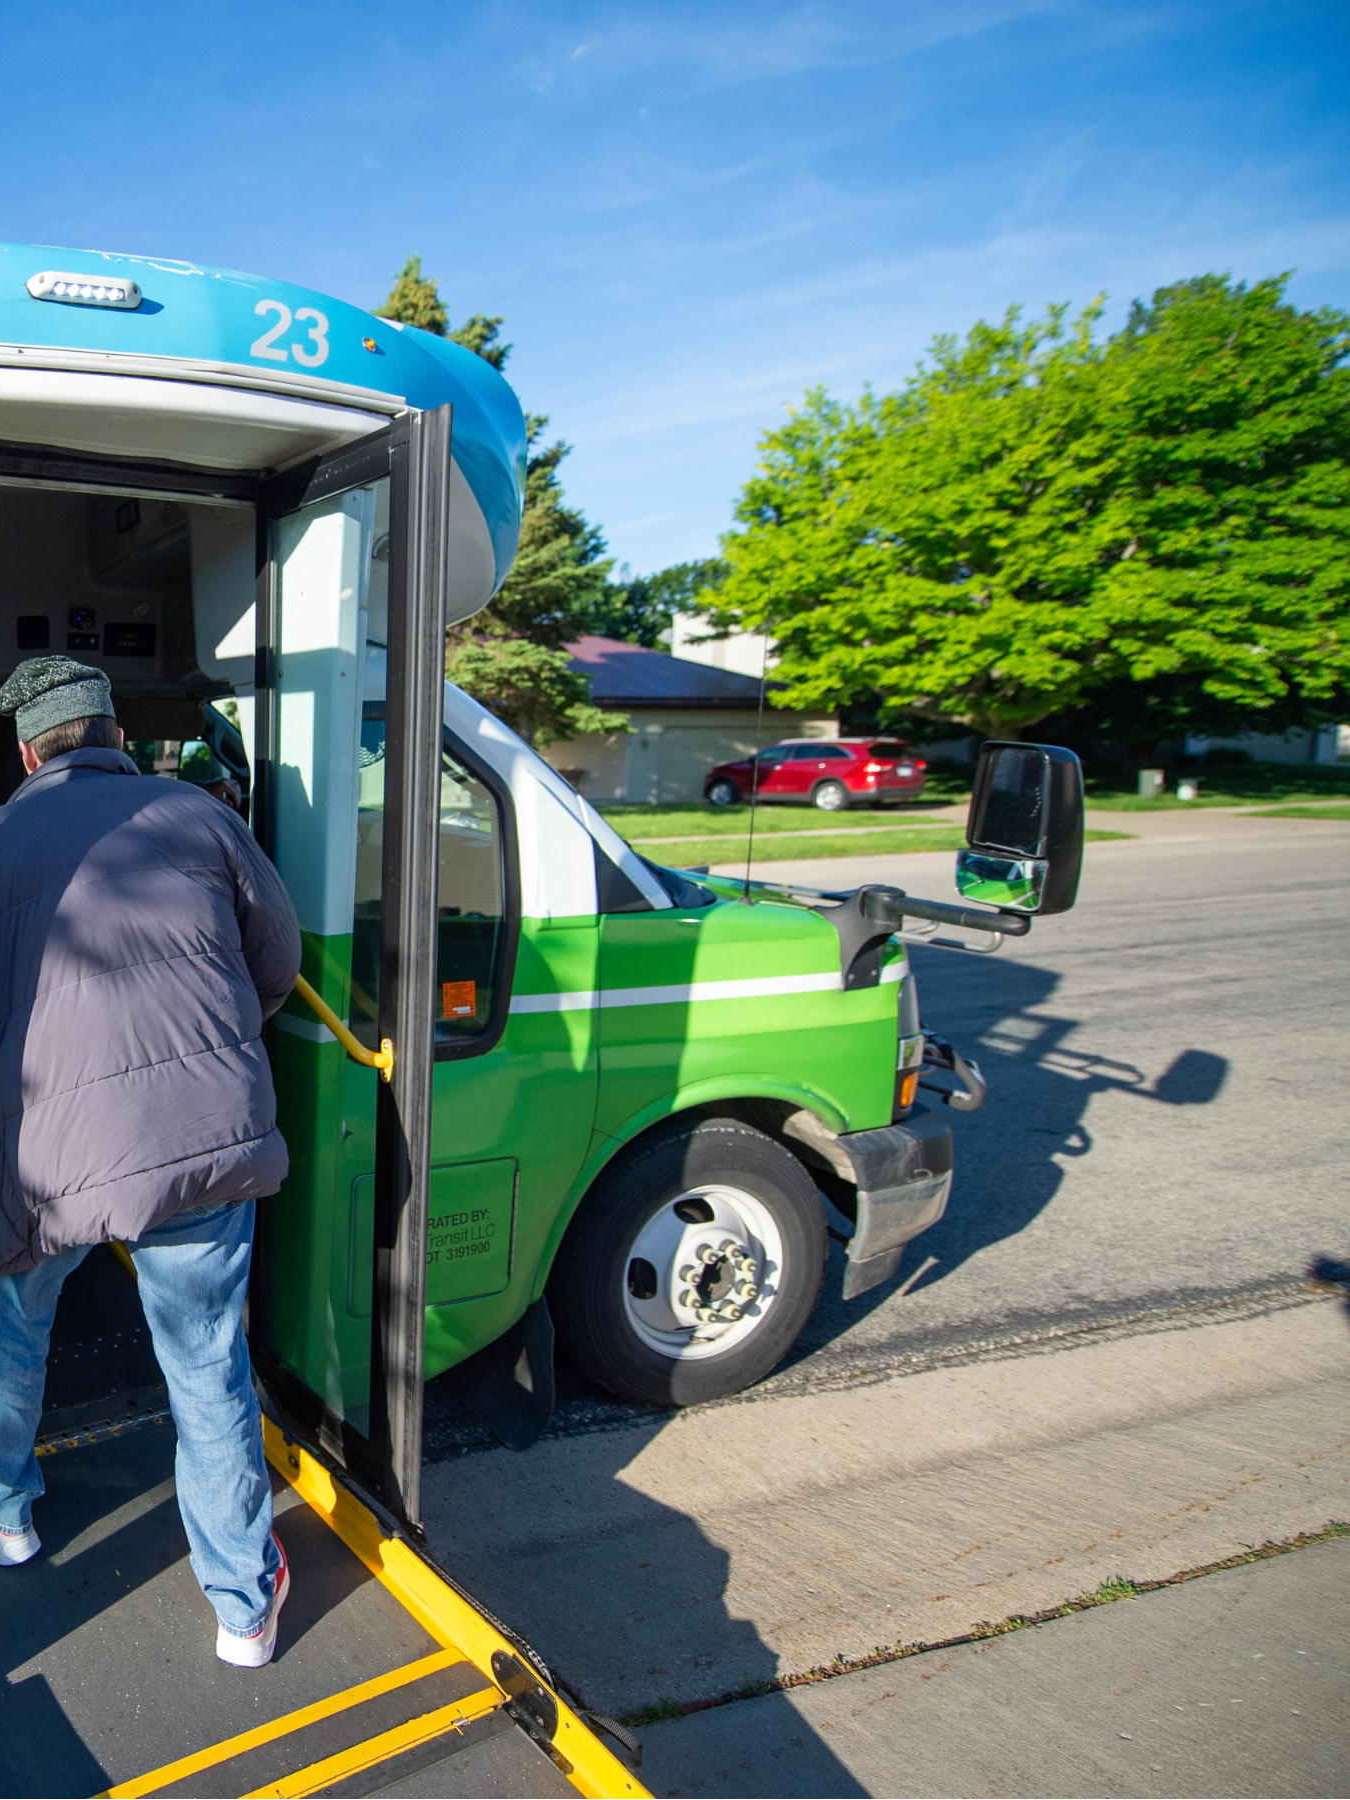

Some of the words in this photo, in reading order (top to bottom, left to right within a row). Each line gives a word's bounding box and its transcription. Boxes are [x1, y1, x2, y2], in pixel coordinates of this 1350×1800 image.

[250, 299, 330, 368] 23
[427, 1212, 469, 1230] RATED
[471, 1208, 490, 1223] BY:
[471, 1222, 495, 1241] LLC
[446, 1241, 490, 1261] 3191900
